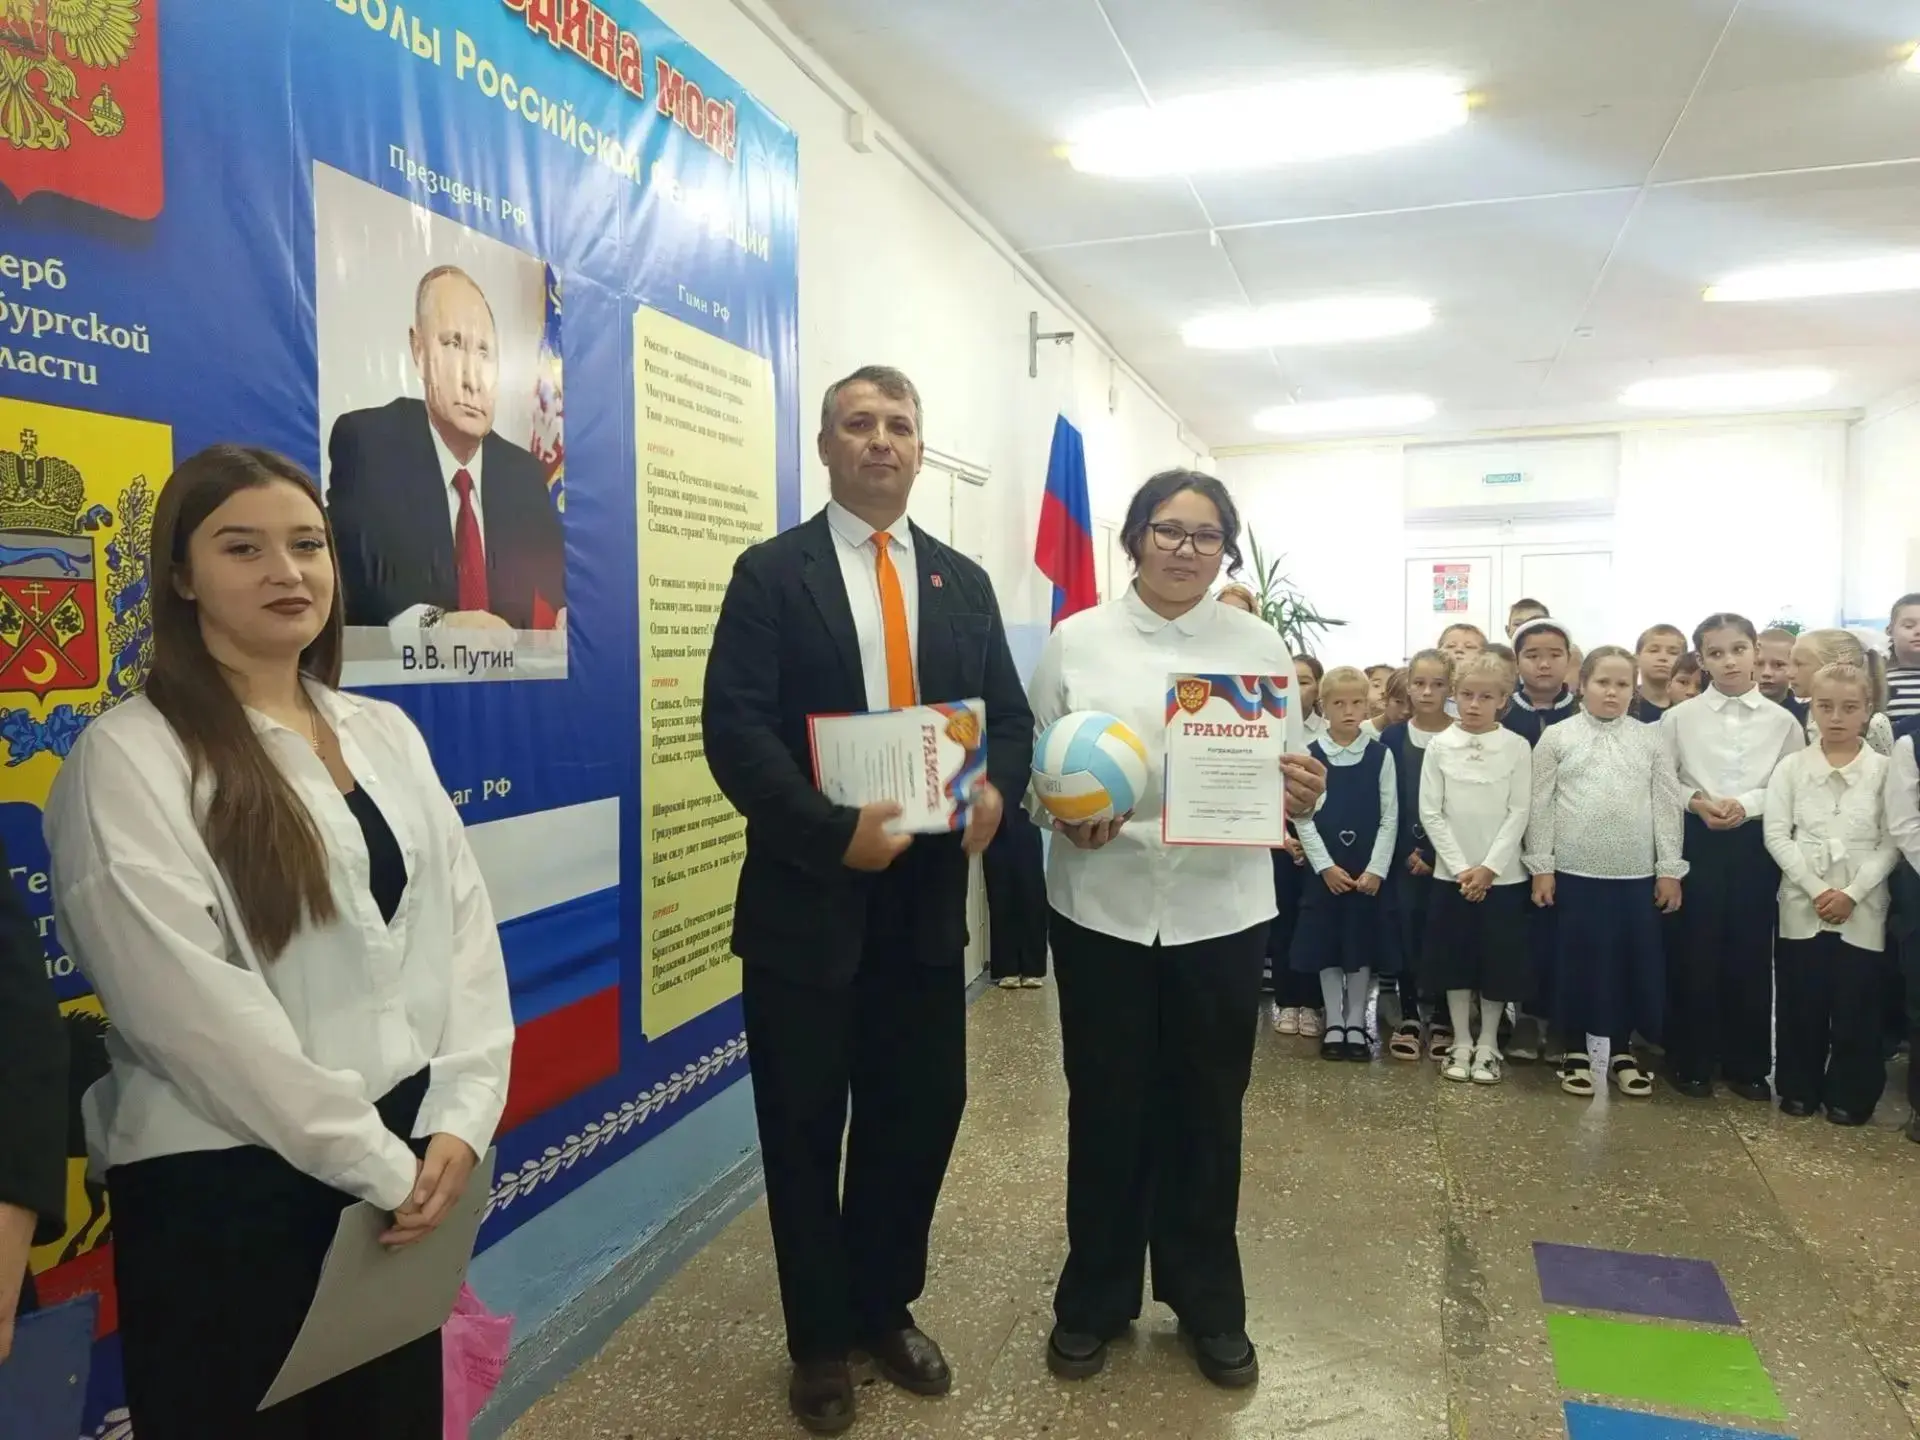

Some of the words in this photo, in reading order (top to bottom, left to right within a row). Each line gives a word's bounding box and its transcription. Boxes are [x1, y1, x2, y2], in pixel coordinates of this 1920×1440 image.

[655, 55, 736, 164] моя!
[389, 143, 493, 213] Президент
[501, 198, 527, 229] РФ
[0, 254, 67, 290] ерб
[677, 283, 708, 314] Гимн
[713, 302, 730, 322] РФ
[649, 574, 659, 587] От
[403, 645, 445, 670] В.В.
[453, 645, 514, 675] Путин
[651, 645, 685, 661] Хранимая
[1183, 722, 1269, 739] ГРАМОТА
[482, 777, 512, 801] РФ
[652, 799, 685, 817] Широкий
[687, 795, 711, 811] простор
[652, 825, 686, 843] Грядущие
[653, 851, 667, 865] Нам
[652, 876, 665, 888] Так
[687, 865, 699, 876] так
[720, 855, 730, 866] так
